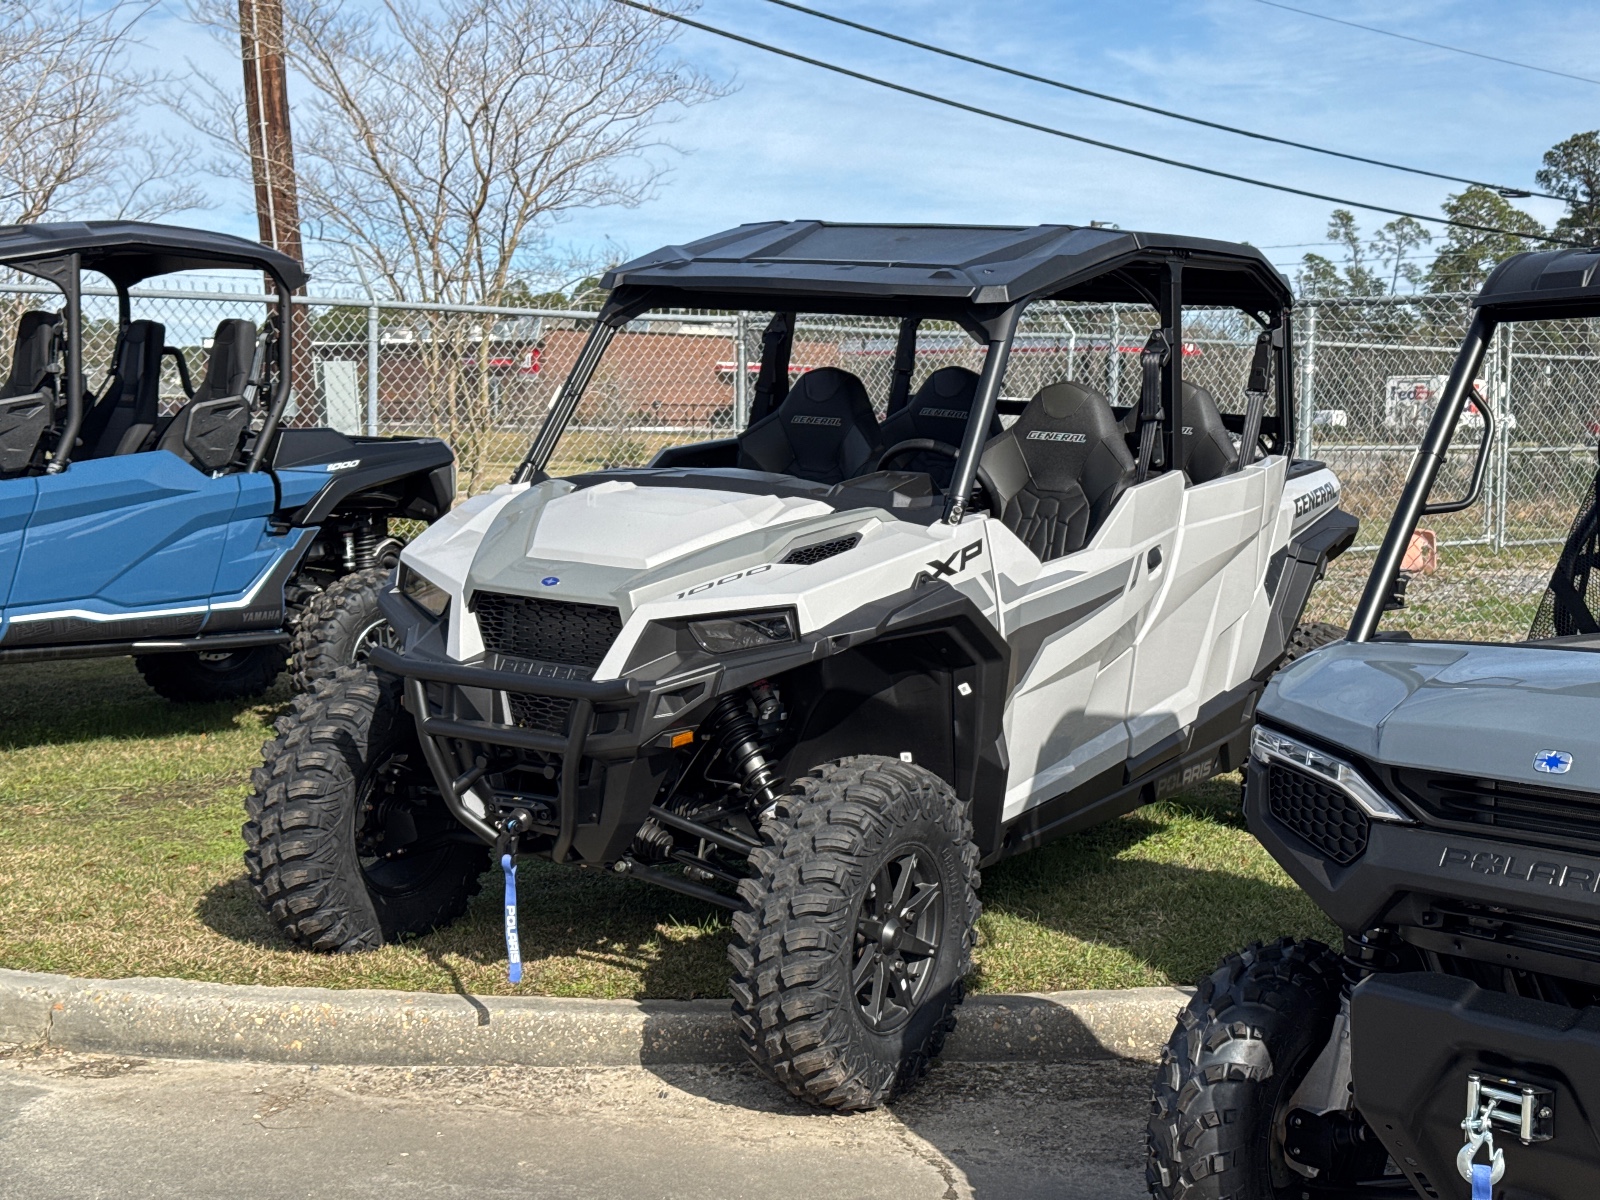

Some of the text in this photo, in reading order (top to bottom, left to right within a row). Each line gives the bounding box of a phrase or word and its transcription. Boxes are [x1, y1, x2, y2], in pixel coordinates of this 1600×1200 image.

[791, 415, 842, 427] GENERAL
[919, 407, 968, 420] GENERAL
[1026, 430, 1087, 443] GENERAL
[326, 459, 361, 472] 1000
[1293, 481, 1338, 519] GENERAL
[926, 538, 983, 578] XP
[677, 564, 773, 600] 1000
[242, 610, 281, 622] YAMAHA
[1156, 758, 1213, 797] POLARIS
[506, 905, 520, 964] POLARIS
